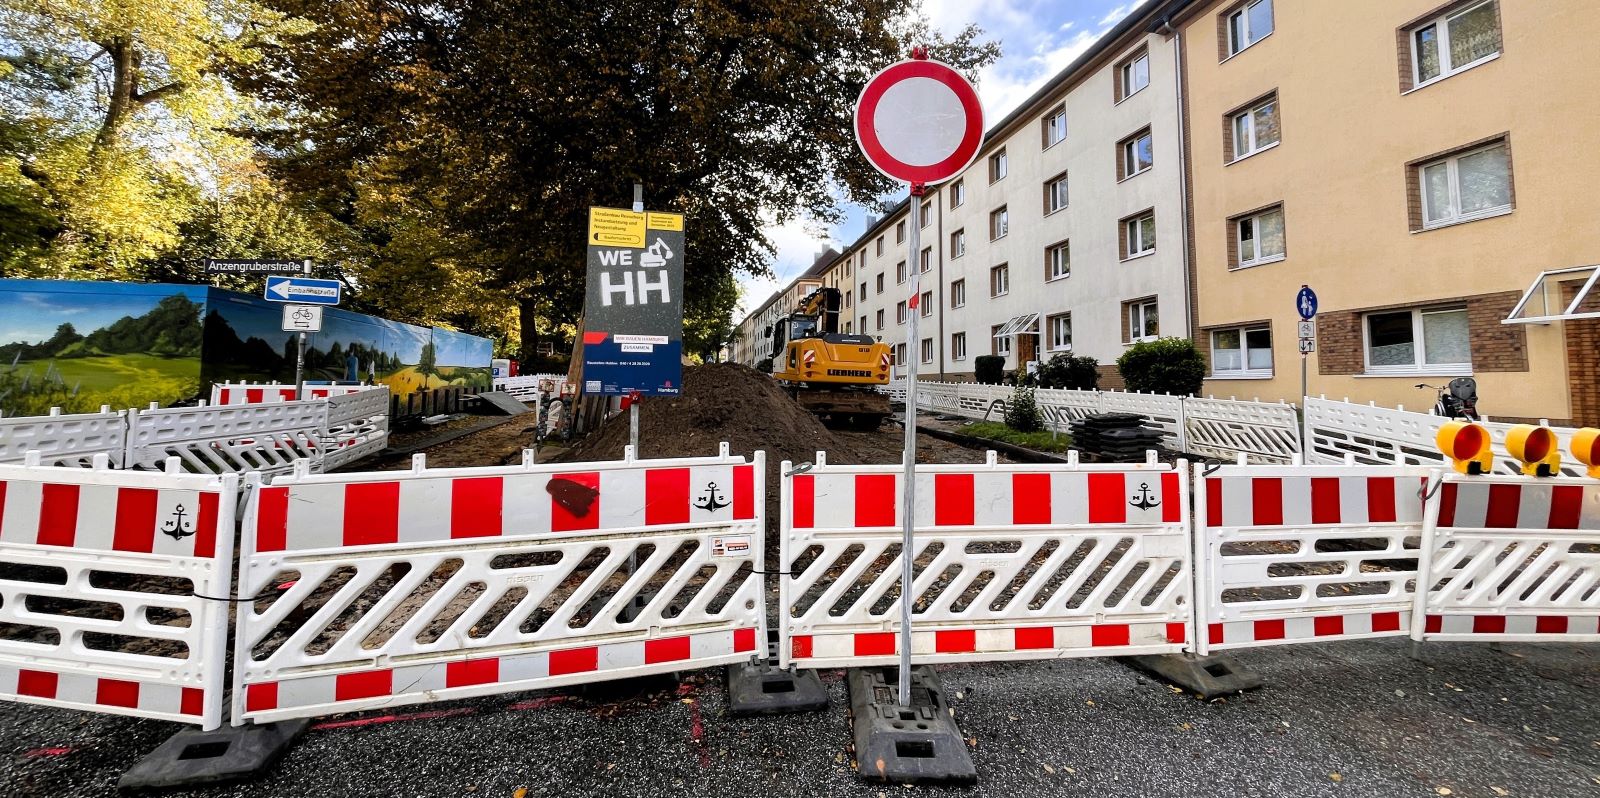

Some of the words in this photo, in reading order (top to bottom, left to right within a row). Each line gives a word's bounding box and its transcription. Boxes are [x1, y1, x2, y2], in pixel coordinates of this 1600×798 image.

[598, 250, 632, 266] WE
[208, 261, 301, 273] Anzengruberstraße
[288, 287, 335, 296] Einbahnstraße
[601, 270, 670, 306] HH
[827, 369, 872, 377] LIEBHERR
